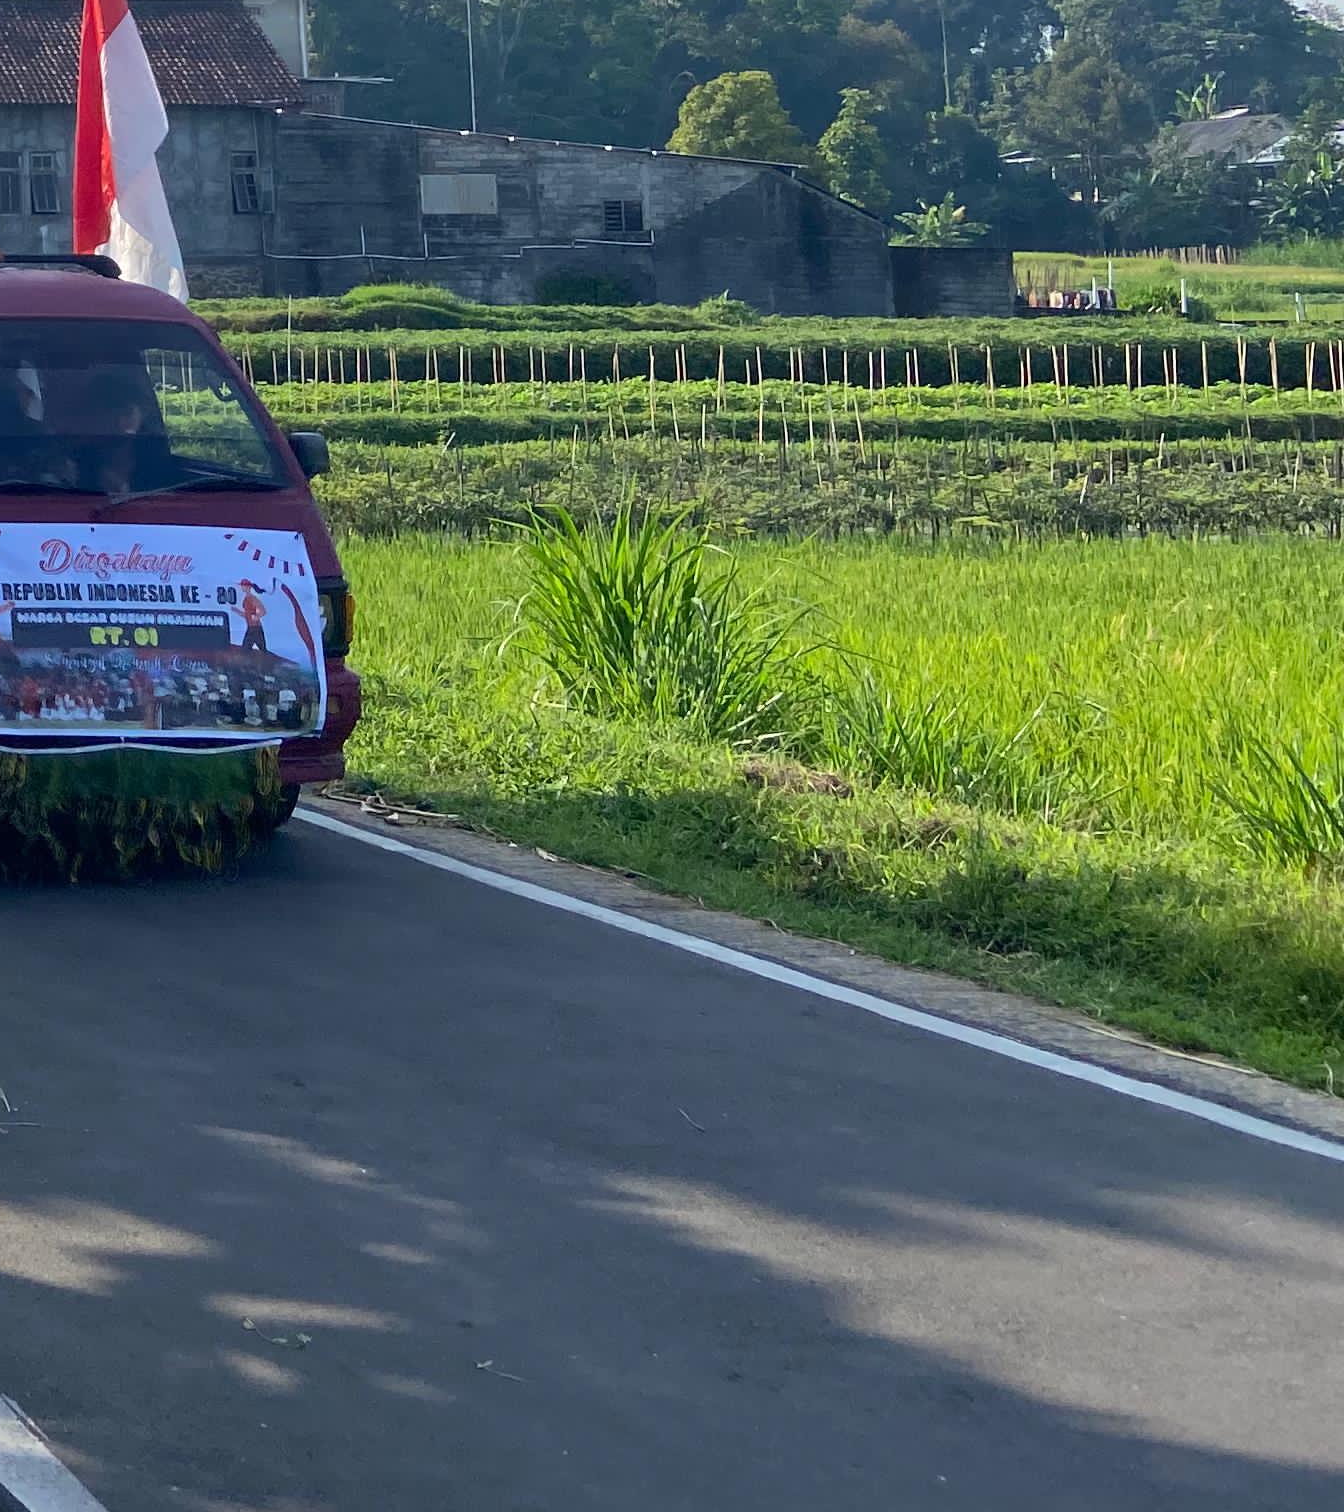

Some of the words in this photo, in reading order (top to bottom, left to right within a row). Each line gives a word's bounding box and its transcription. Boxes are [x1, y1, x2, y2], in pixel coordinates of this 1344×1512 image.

[39, 539, 193, 582] Dirgahayu
[1, 583, 82, 601] REPUBLIK
[87, 583, 176, 604] INDONESIA
[180, 585, 201, 605] KE
[216, 586, 238, 606] 80
[16, 612, 63, 624] WARGA
